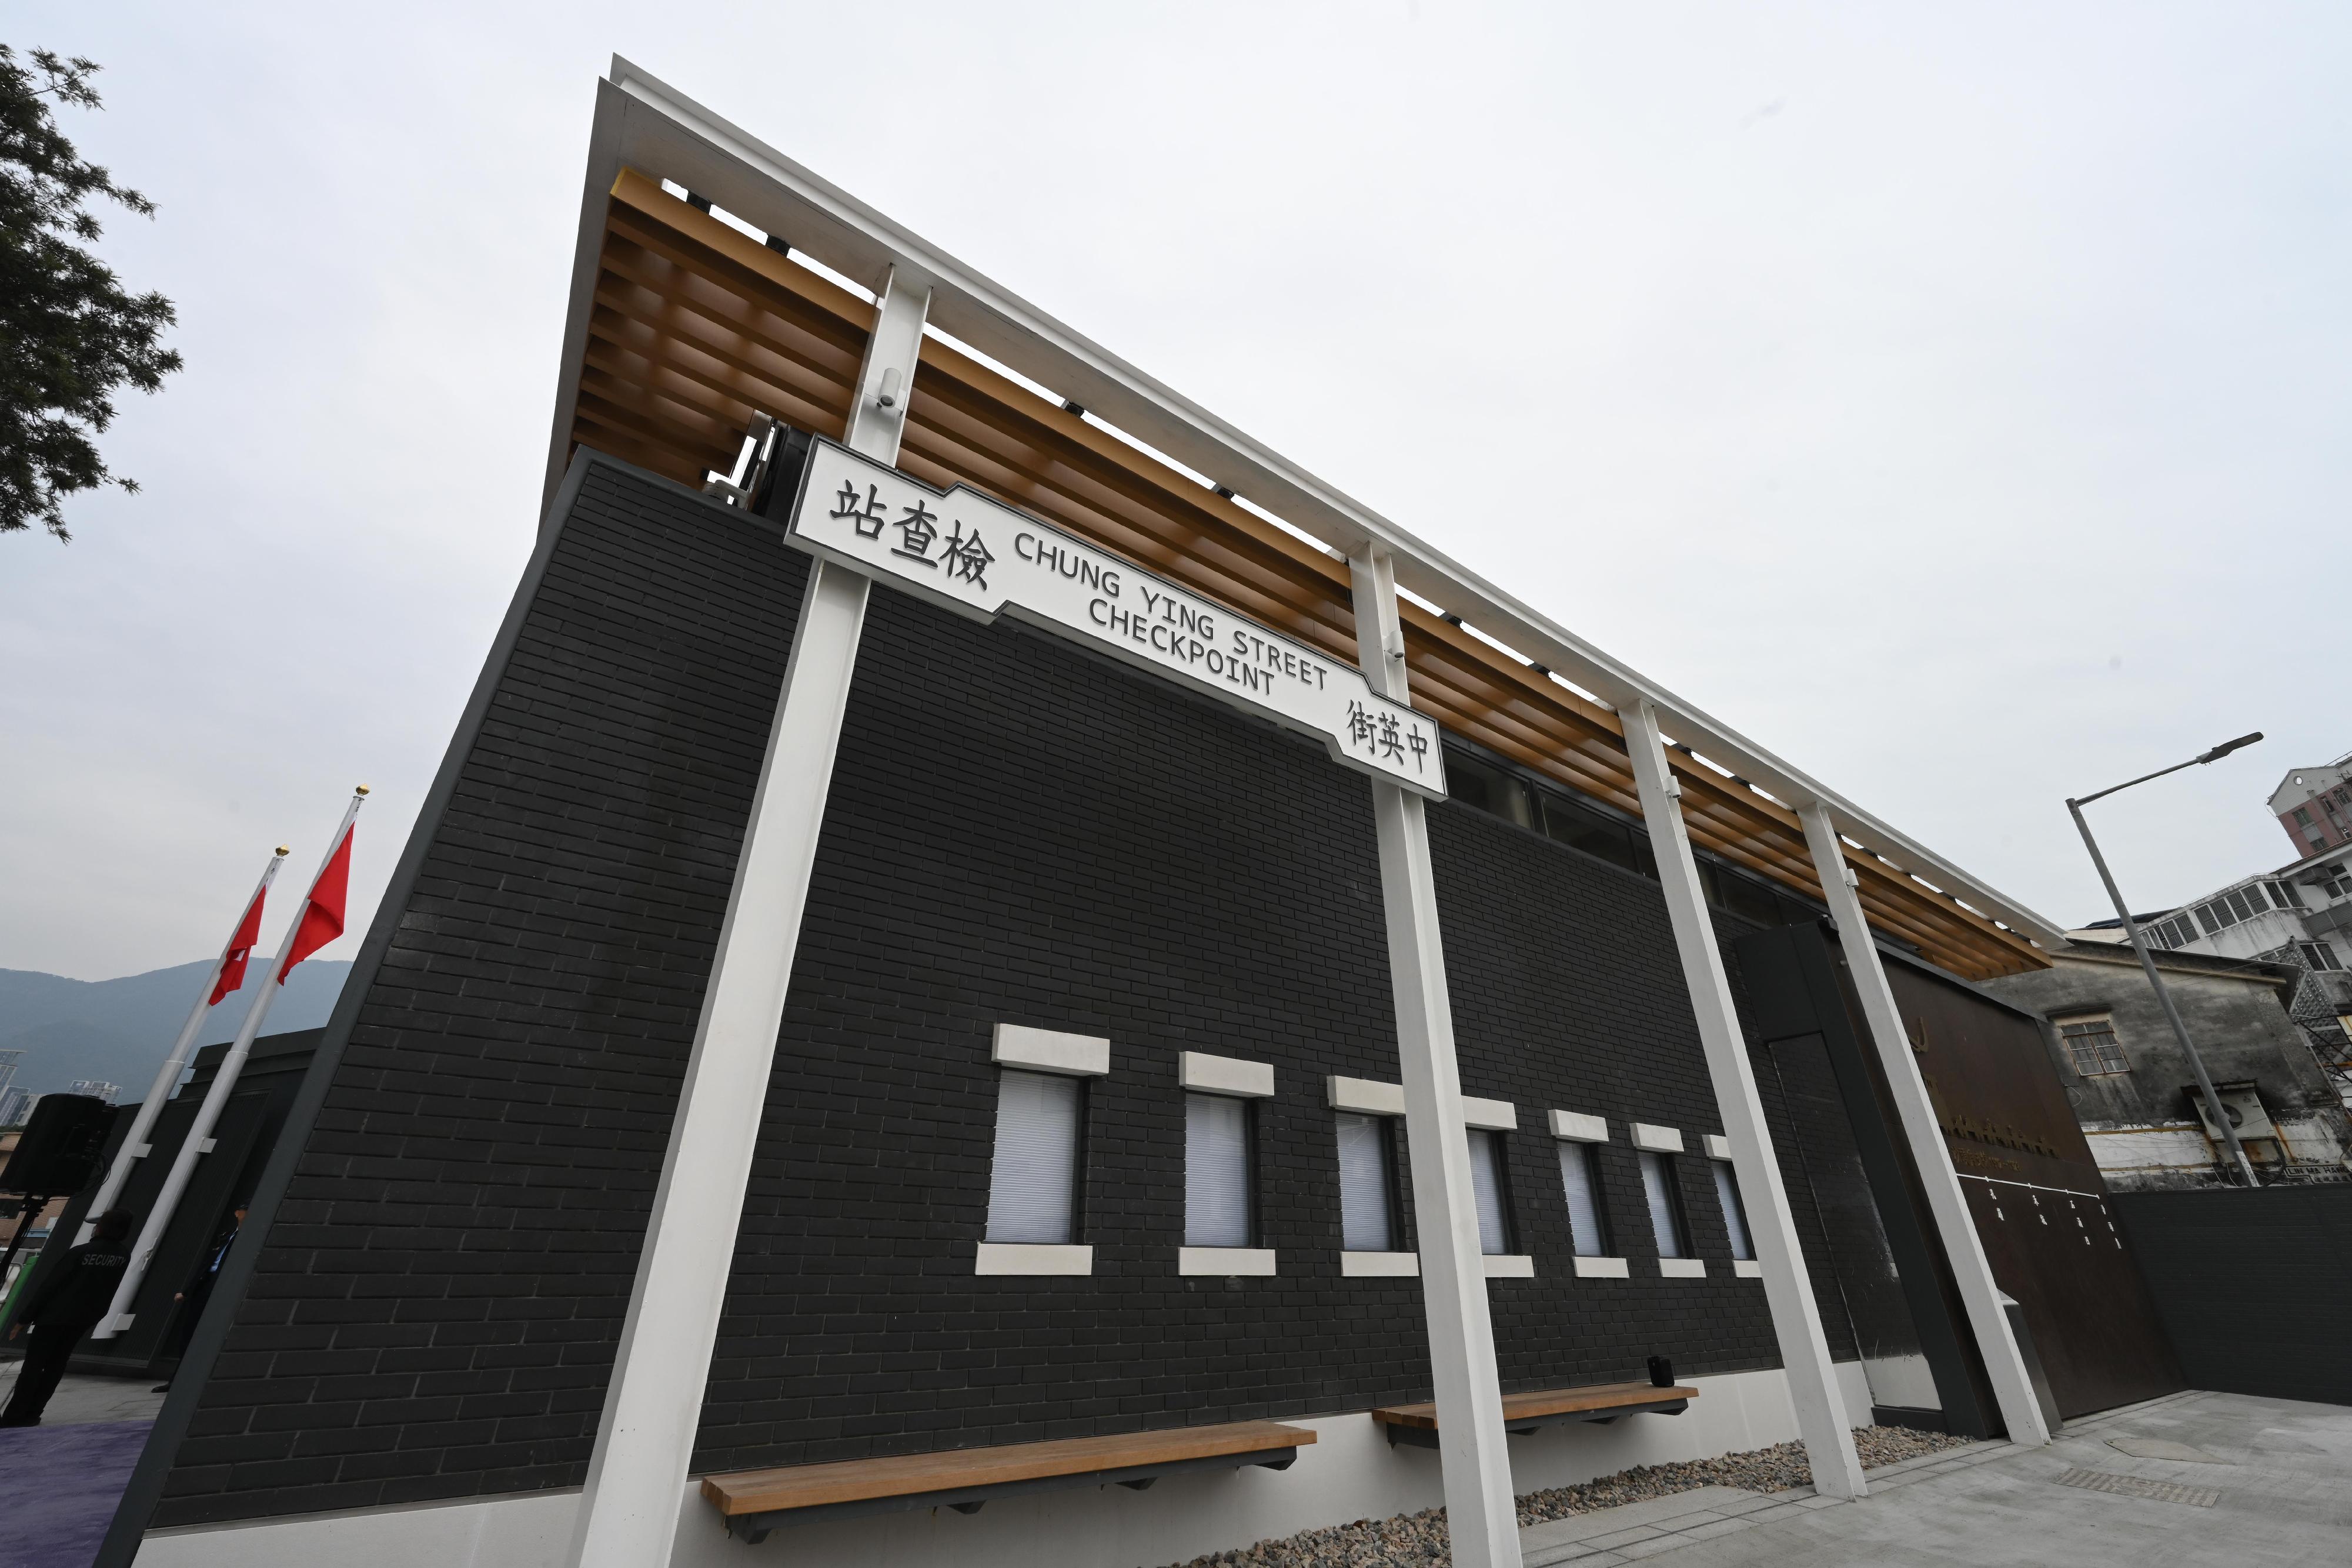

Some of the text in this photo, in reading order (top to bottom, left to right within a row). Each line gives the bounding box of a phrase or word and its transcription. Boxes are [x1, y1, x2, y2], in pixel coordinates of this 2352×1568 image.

[1015, 533, 1327, 690] CHUNG YING STREET
[1090, 598, 1275, 695] CHECKPOINT
[81, 1253, 126, 1266] SECURITY
